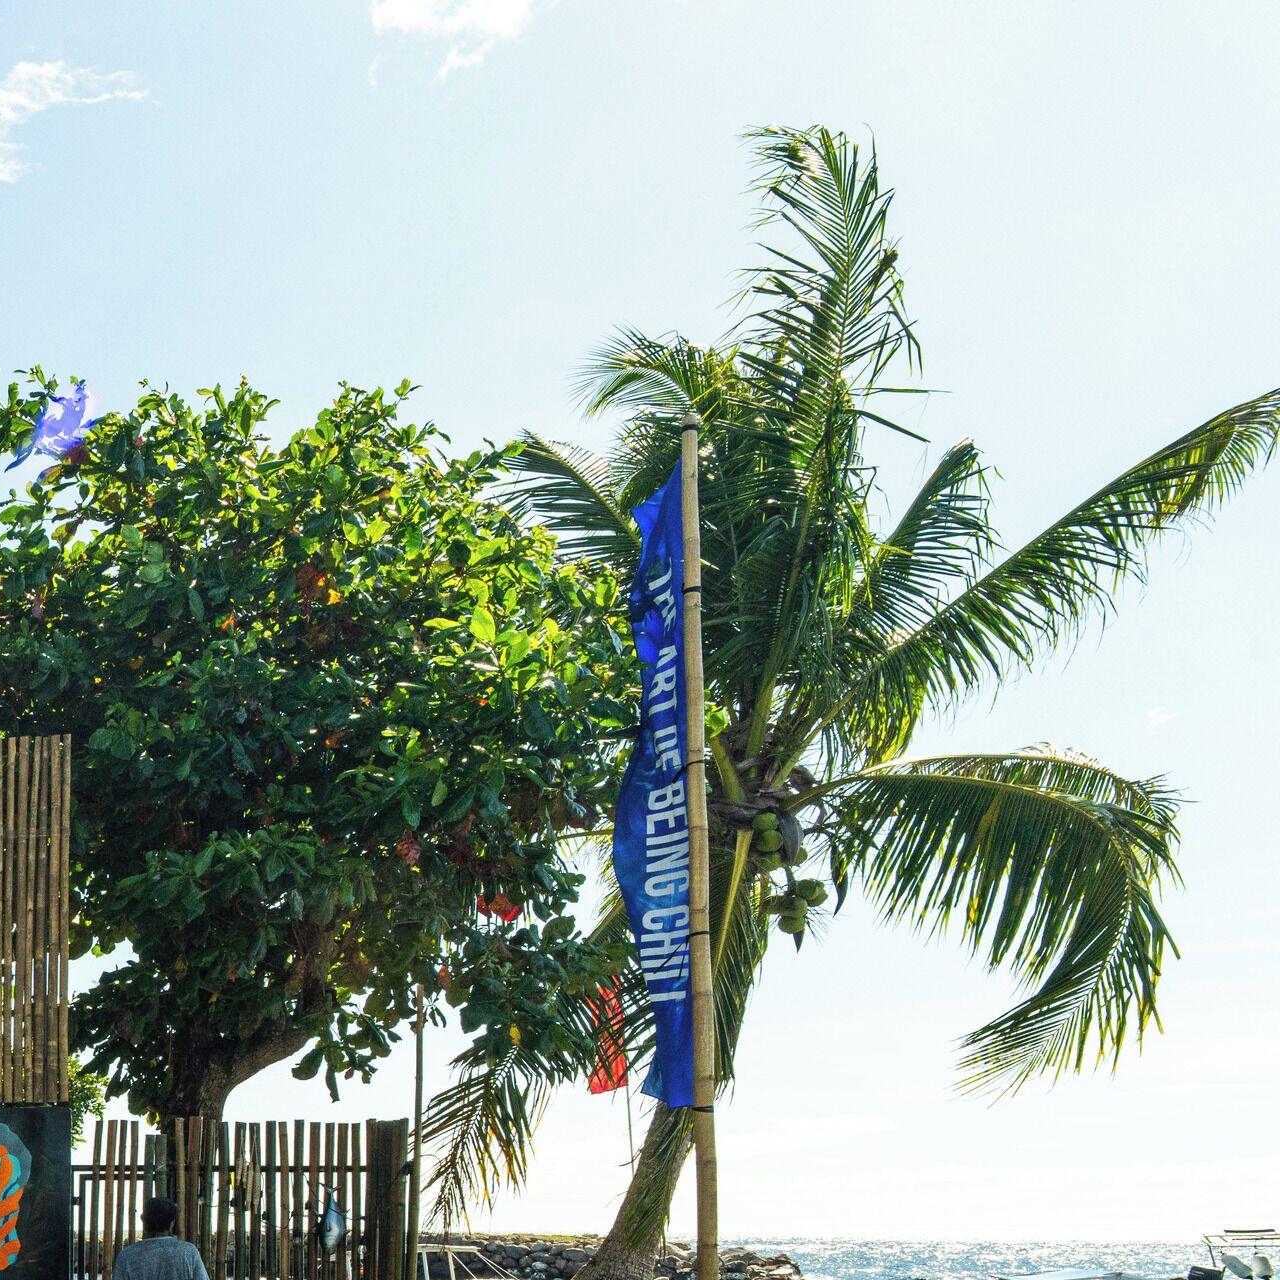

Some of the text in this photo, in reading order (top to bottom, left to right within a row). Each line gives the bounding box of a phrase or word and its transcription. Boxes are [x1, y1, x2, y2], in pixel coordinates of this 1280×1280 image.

[648, 645, 678, 717] ART
[652, 725, 683, 771] OF
[644, 780, 690, 897] BEING
